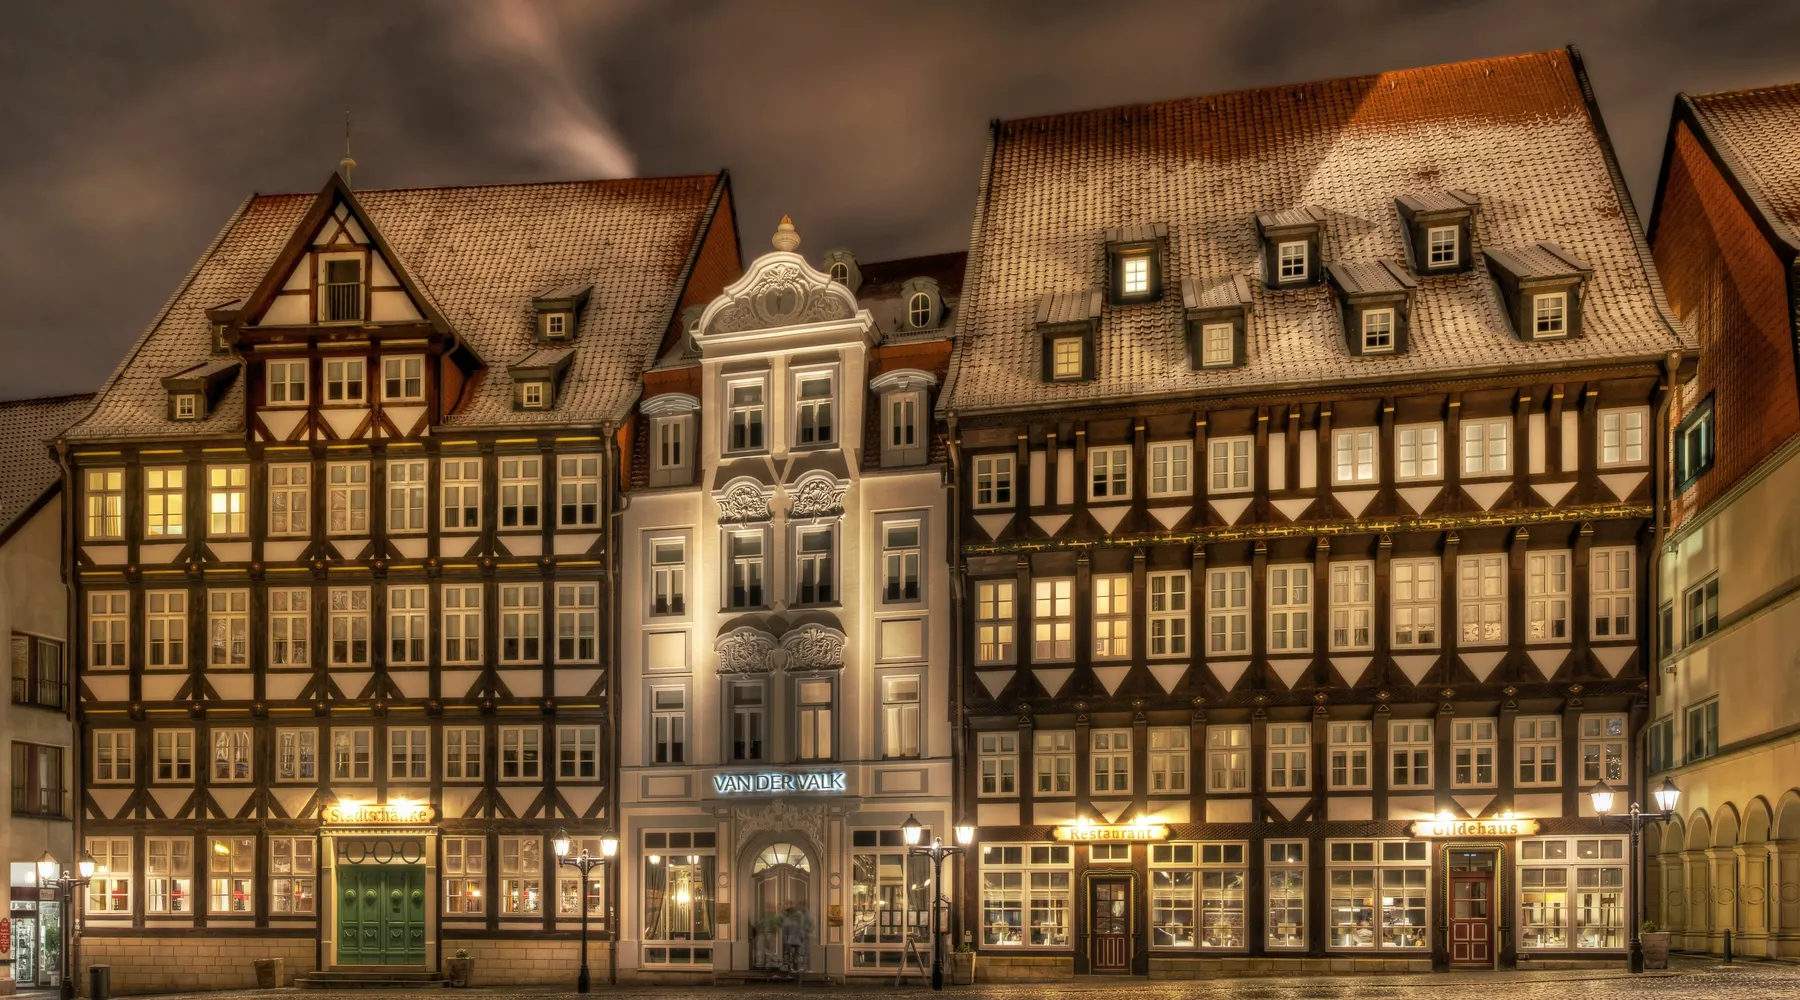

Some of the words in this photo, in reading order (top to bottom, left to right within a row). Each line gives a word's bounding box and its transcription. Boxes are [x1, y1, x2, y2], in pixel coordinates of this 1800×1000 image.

[713, 775, 751, 791] VAN
[756, 774, 795, 790] DER
[797, 773, 844, 790] VALK
[1069, 827, 1153, 840] Restaurant
[1432, 821, 1519, 836] Gildehaus
